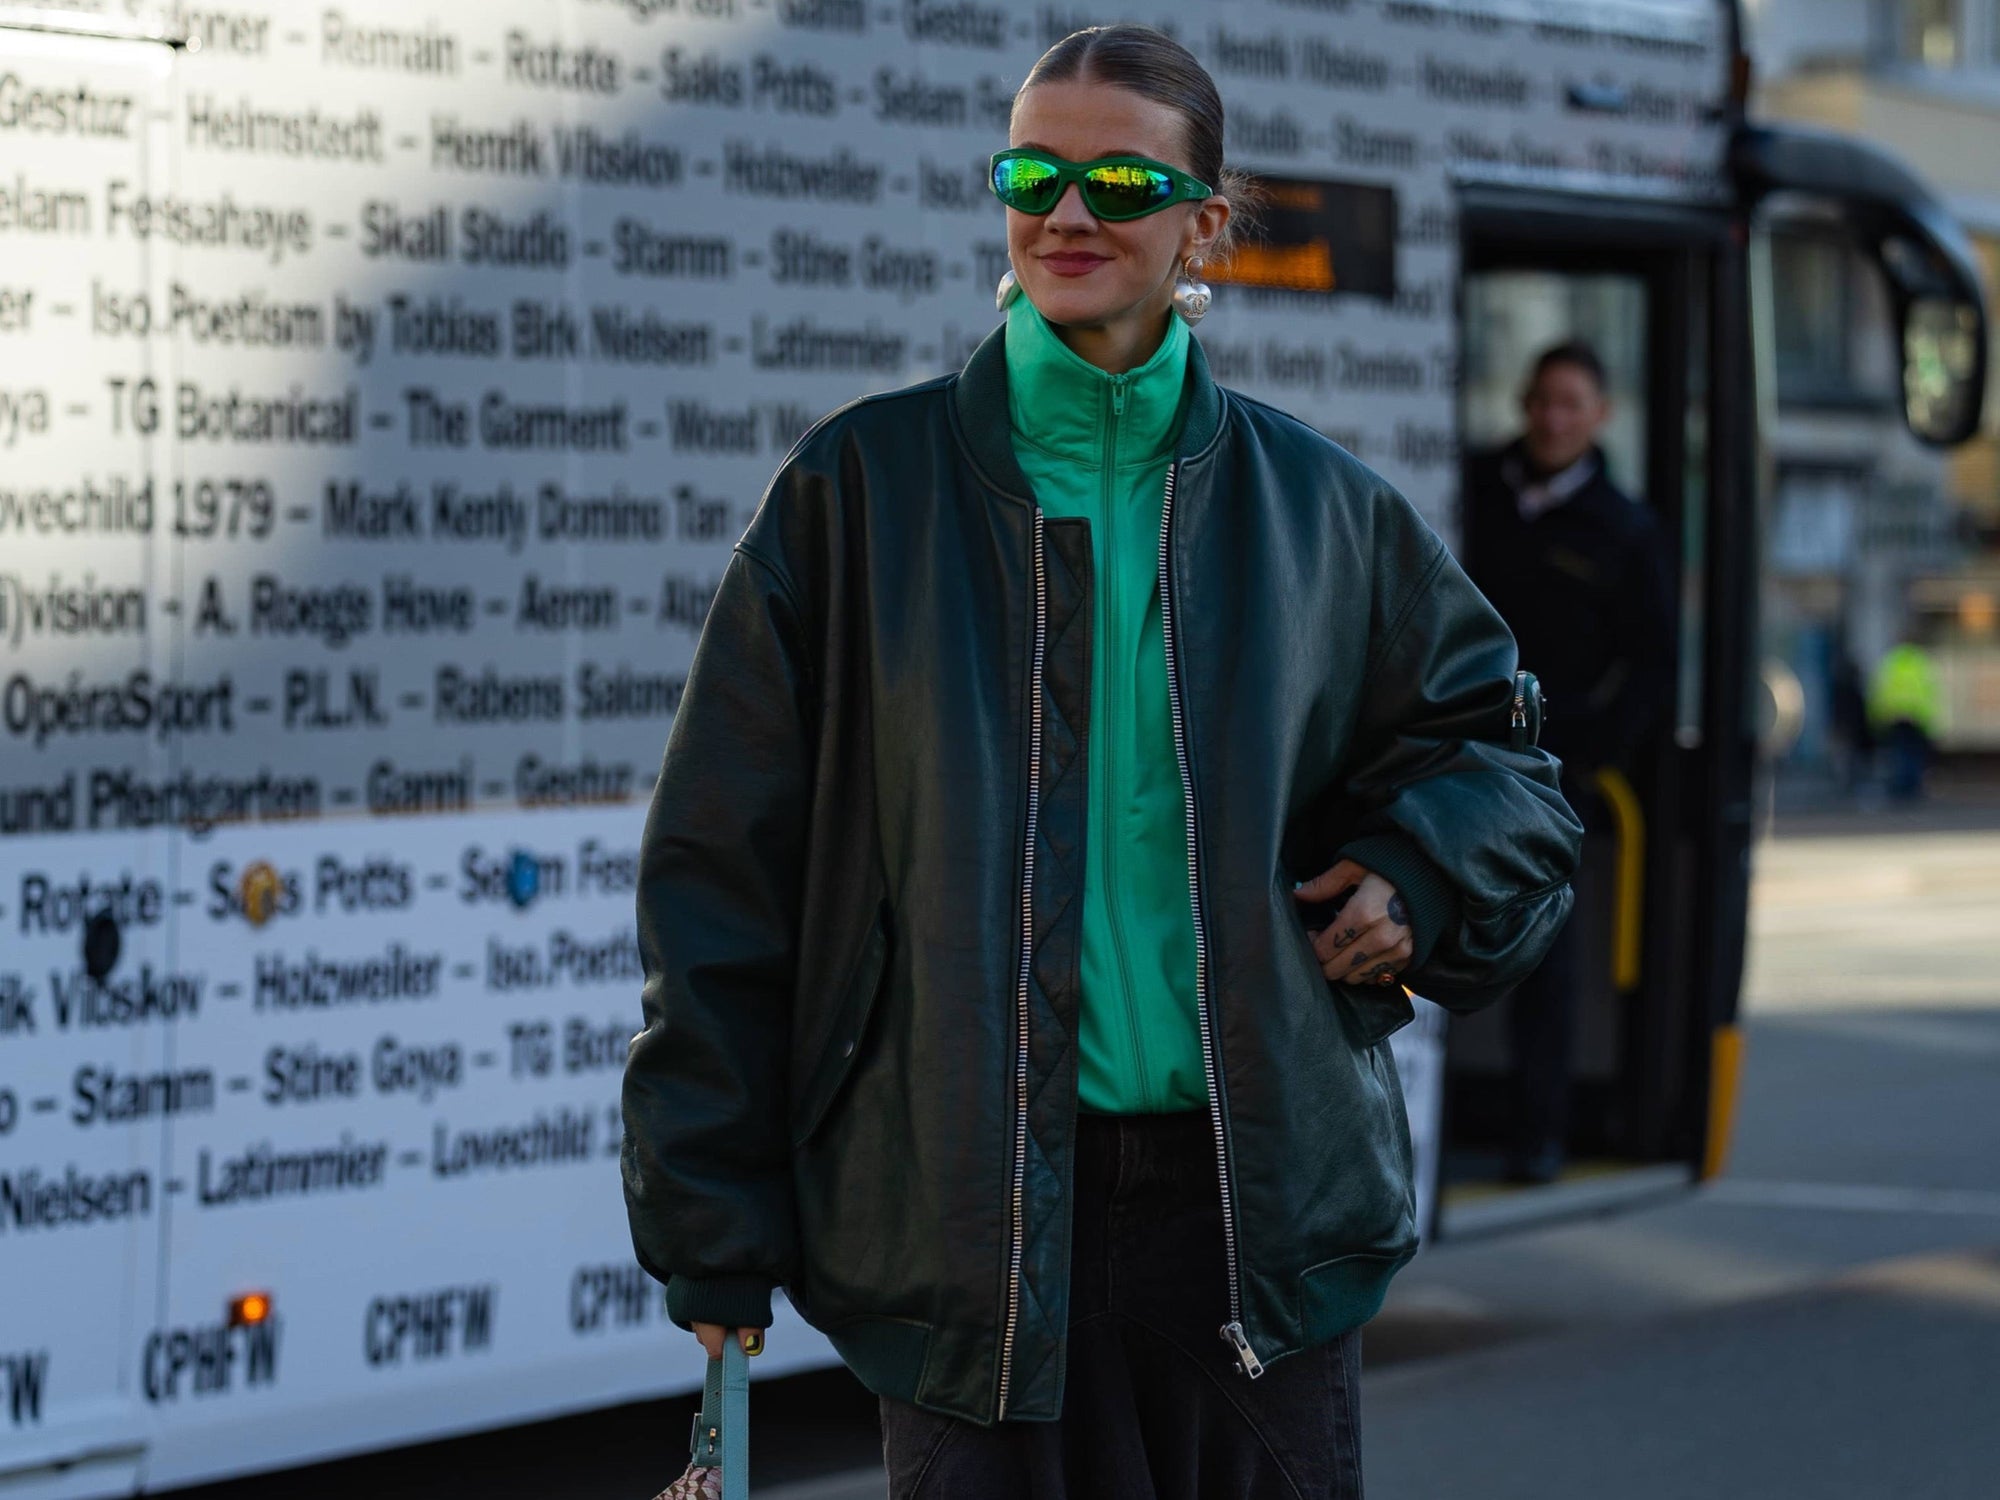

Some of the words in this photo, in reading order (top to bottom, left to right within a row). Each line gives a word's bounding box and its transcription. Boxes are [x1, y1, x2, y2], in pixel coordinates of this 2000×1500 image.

[323, 10, 458, 75] Remain
[505, 32, 619, 95] Rotate
[661, 48, 743, 107] Saks
[751, 55, 838, 117] Potts
[874, 67, 967, 127] Selam
[0, 73, 132, 138] Gestuz
[187, 95, 383, 162] Helmstedt
[432, 113, 540, 178] Henrik
[552, 125, 684, 190] Vibskov
[724, 138, 883, 203] Holzweiler
[107, 180, 312, 265] Fessahaye
[362, 203, 449, 262] Skall
[459, 208, 568, 270] Studio
[613, 218, 735, 278] Stamm
[770, 228, 850, 286] Stine
[860, 232, 940, 302] Goya
[335, 298, 374, 366] by
[388, 296, 498, 360] Tobias
[512, 300, 578, 360] Birk
[590, 310, 713, 367] Nielsen
[753, 315, 907, 373] Latimmier
[106, 377, 160, 434] TG
[177, 383, 357, 444] Botanical
[405, 388, 468, 448] The
[480, 393, 627, 452] Garment
[172, 480, 274, 540] 1979
[323, 480, 420, 540] Mark
[433, 482, 524, 555] Kenly
[538, 484, 664, 540] Domino
[672, 485, 732, 538] Tan
[196, 577, 236, 635] A.
[250, 575, 370, 650] Roege
[383, 573, 473, 632] Hove
[518, 577, 617, 631] Aeron
[4, 668, 236, 748] OpéraSport
[285, 668, 388, 730] P.L.N.
[434, 662, 566, 724] Rabens
[577, 663, 687, 722] Salone
[90, 768, 320, 840] Pferdgarten
[371, 760, 474, 814] Ganni
[519, 754, 632, 805] Gestuz
[19, 872, 163, 936] Rotate
[208, 860, 301, 922] Ss
[315, 854, 414, 913] Potts
[460, 845, 570, 905] Sem
[50, 962, 205, 1032] Vibskov
[255, 945, 442, 1012] Holzweiler
[72, 1065, 215, 1127] Stamm
[262, 1045, 360, 1104] Stine
[372, 1035, 462, 1100] Goya
[506, 1022, 553, 1078] TG
[0, 1163, 150, 1232] Nielsen
[198, 1138, 388, 1207] Latimmier
[432, 1107, 592, 1178] Lovechild
[140, 1311, 282, 1403] CPHFW
[364, 1282, 500, 1368] CPHFW
[570, 1255, 664, 1333] CPHF
